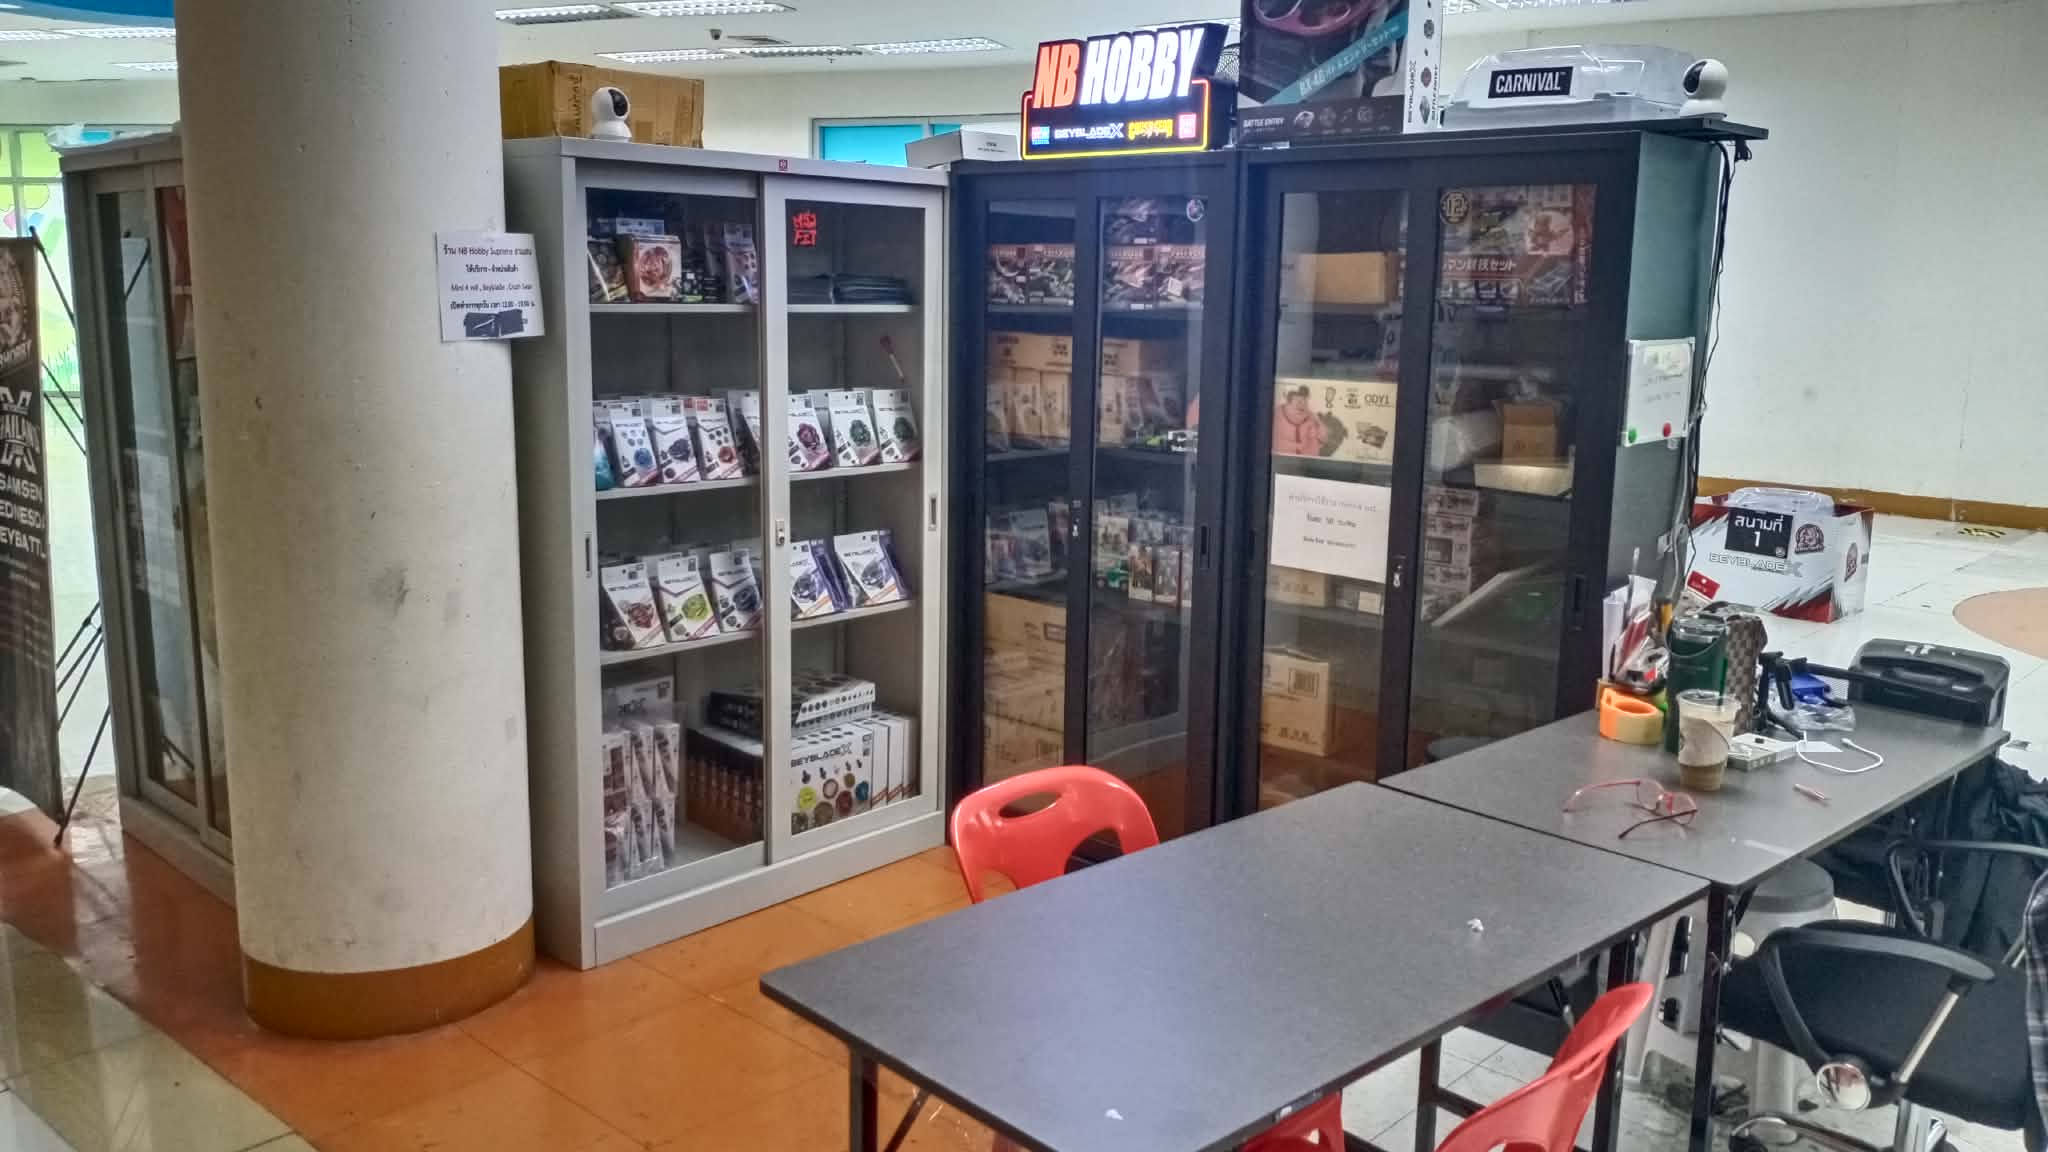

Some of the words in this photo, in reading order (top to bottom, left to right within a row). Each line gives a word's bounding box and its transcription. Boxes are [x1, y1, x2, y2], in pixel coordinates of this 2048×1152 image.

[1033, 40, 1080, 109] NB
[1079, 27, 1206, 106] HOBBY
[1495, 71, 1561, 94] CARNIVAL
[469, 247, 489, 256] Hobby
[1734, 515, 1784, 533] สนามที่
[1754, 531, 1761, 548] 1
